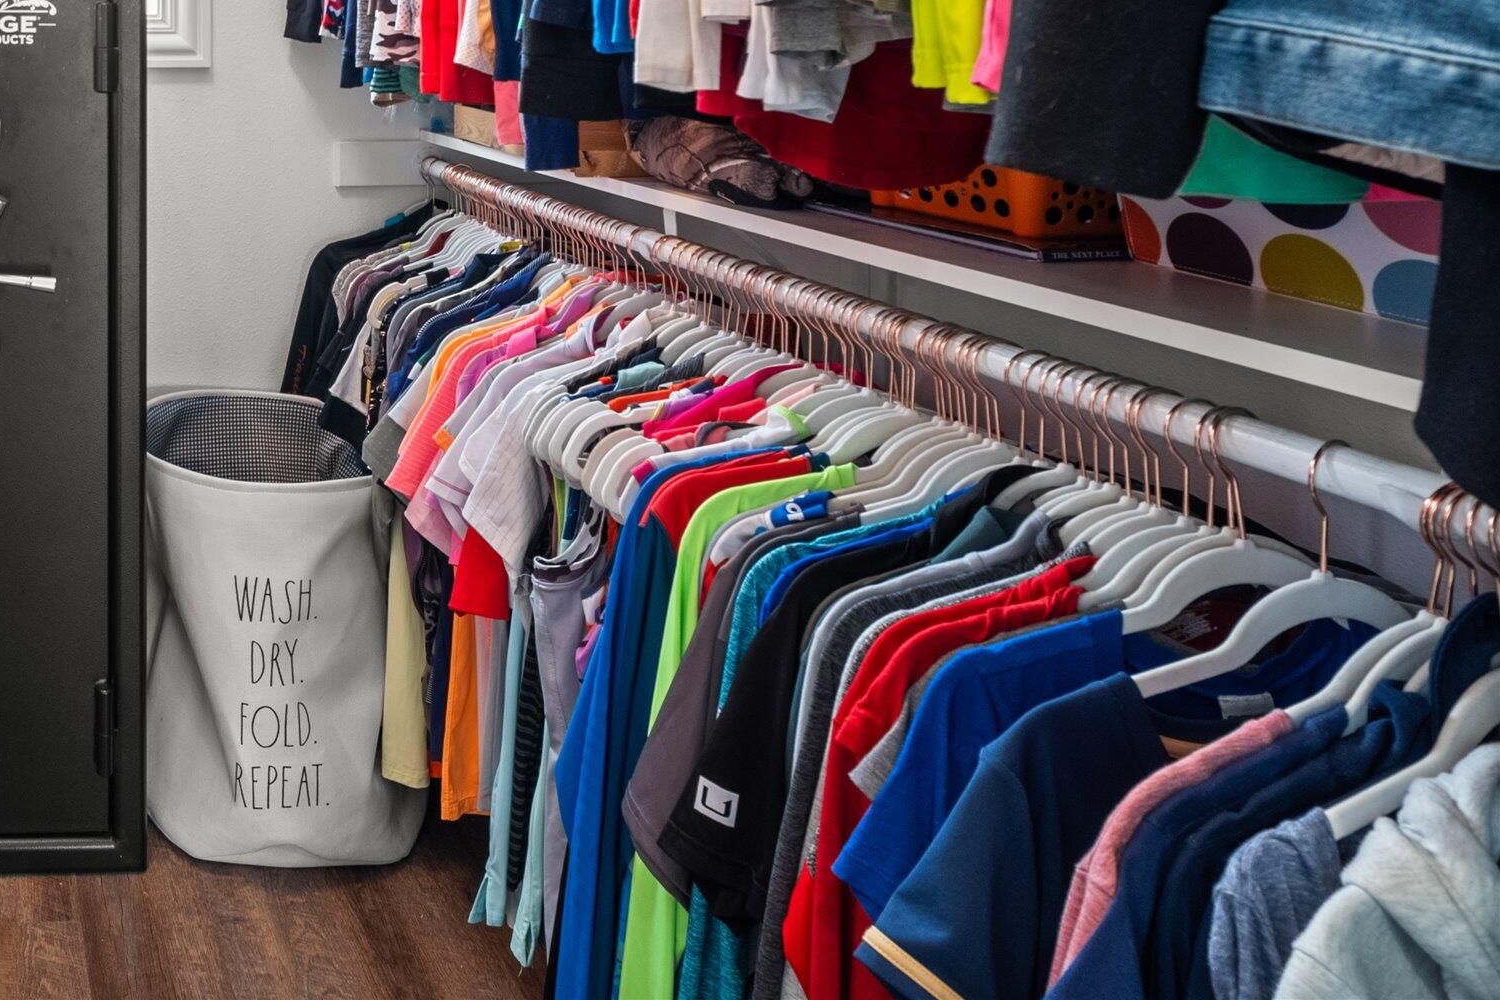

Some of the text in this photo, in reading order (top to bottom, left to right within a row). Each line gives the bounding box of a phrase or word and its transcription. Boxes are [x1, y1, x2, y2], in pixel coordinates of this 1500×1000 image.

[1052, 250, 1121, 260] THE NEXT PLACE
[234, 574, 318, 625] WASH.
[250, 638, 304, 687] DRY.
[240, 701, 318, 748] FOLD.
[233, 761, 330, 810] REPEAT.
